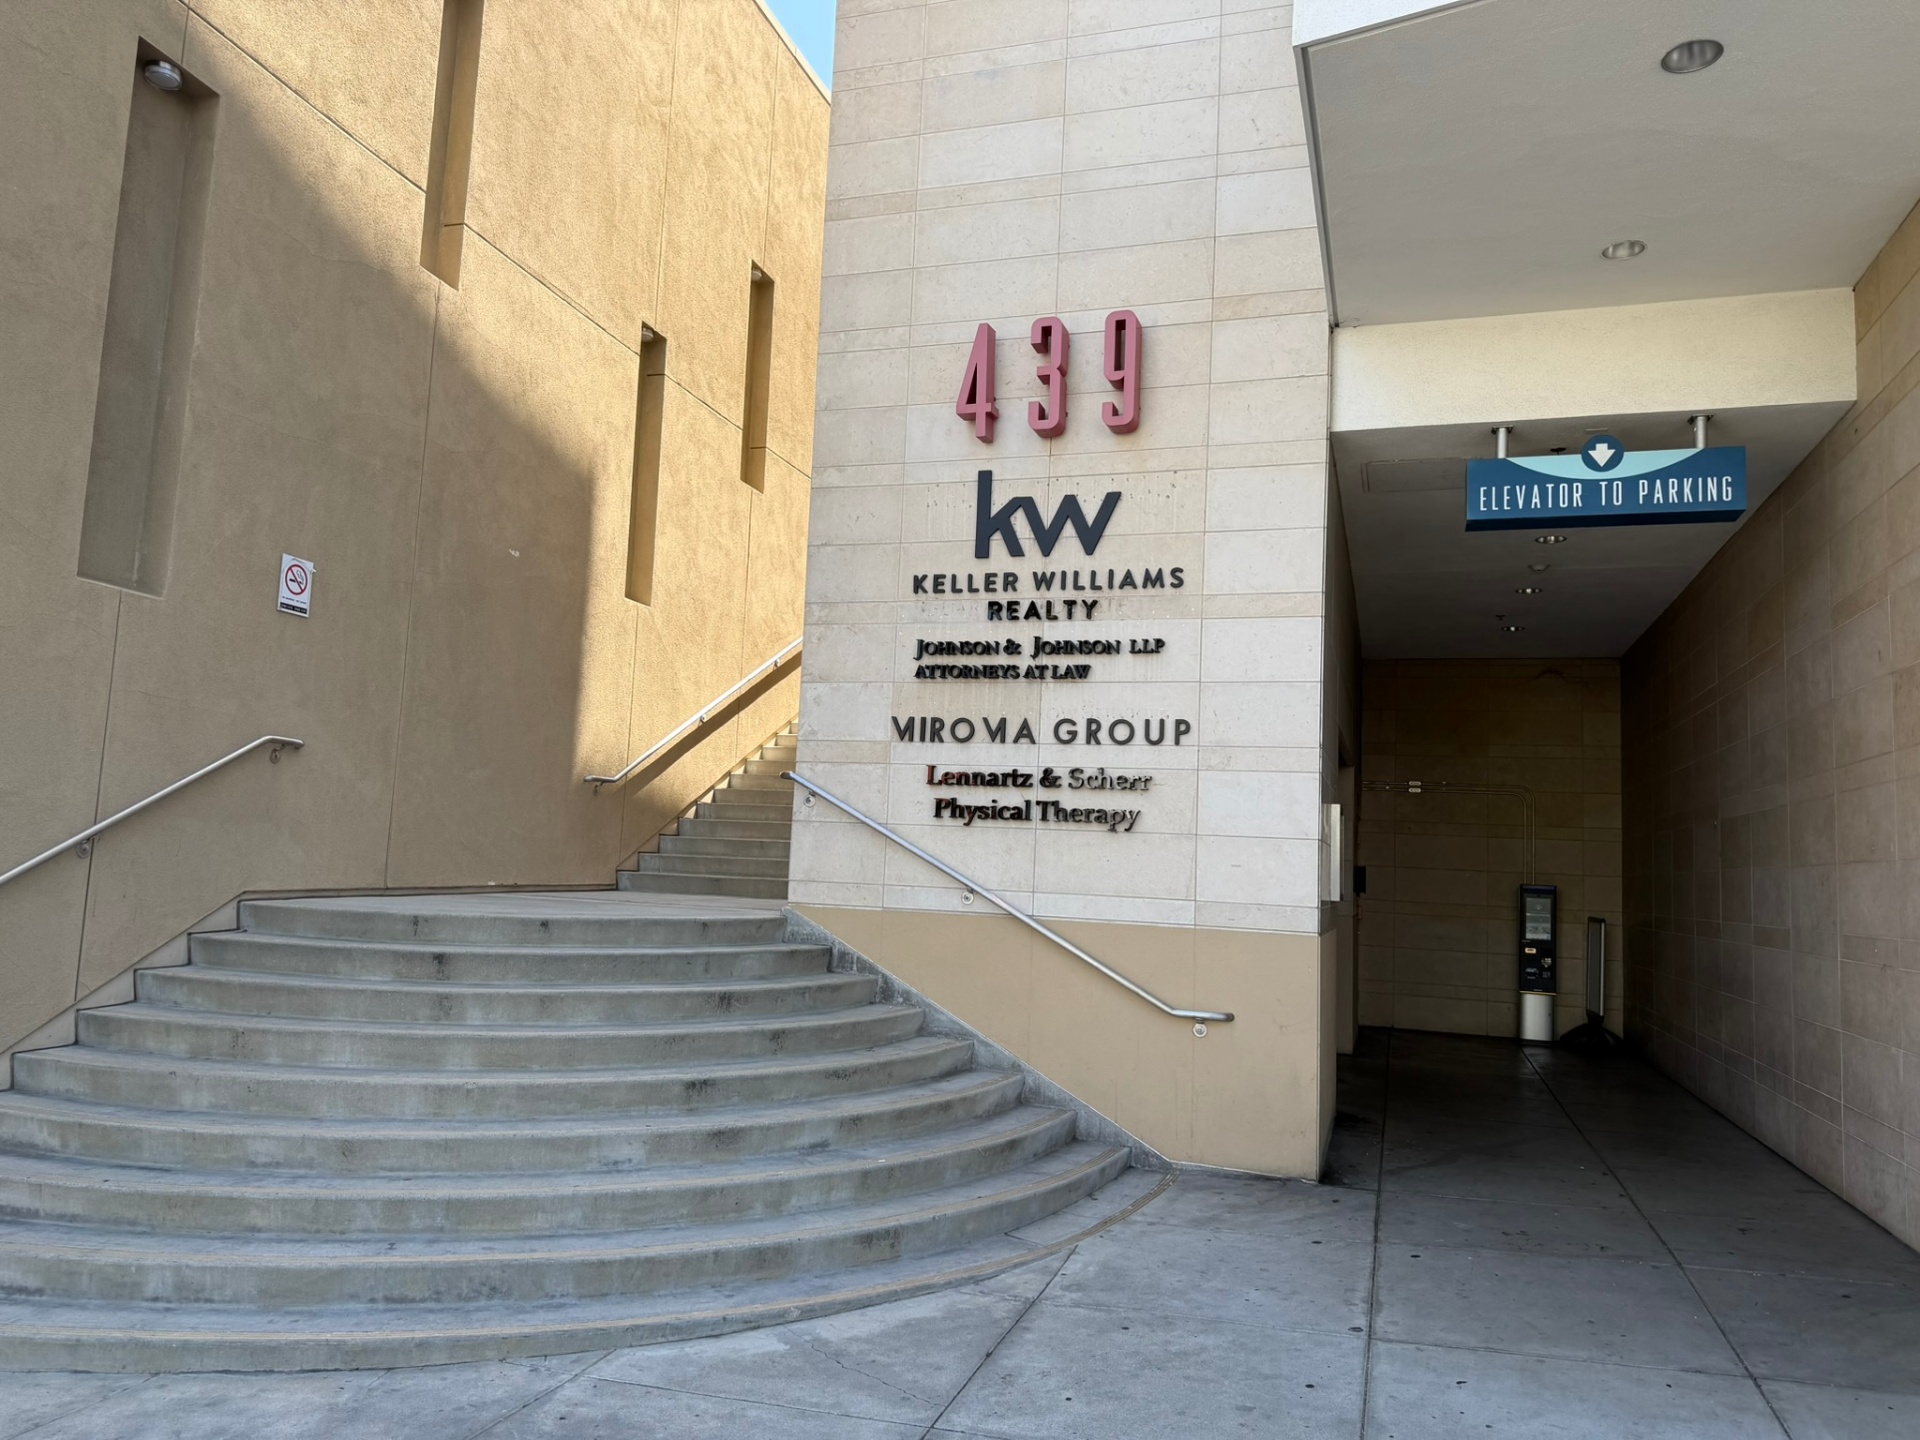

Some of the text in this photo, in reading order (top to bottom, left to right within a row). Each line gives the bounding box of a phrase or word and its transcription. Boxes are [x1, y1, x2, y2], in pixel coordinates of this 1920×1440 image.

[956, 309, 1141, 443] 439
[1479, 476, 1733, 511] ELEVATOR TO PARKING
[913, 567, 1185, 594] KELLER WILLIAMS
[987, 599, 1099, 621] REALTY
[914, 636, 1166, 661] JOHNSON & JOHNSON LLP
[914, 664, 1091, 680] ATTORNEYS AT LAW
[1053, 718, 1191, 746] GROUP
[926, 764, 1153, 791] Lennartz & Scherr
[933, 797, 1141, 832] Physical Therapy
